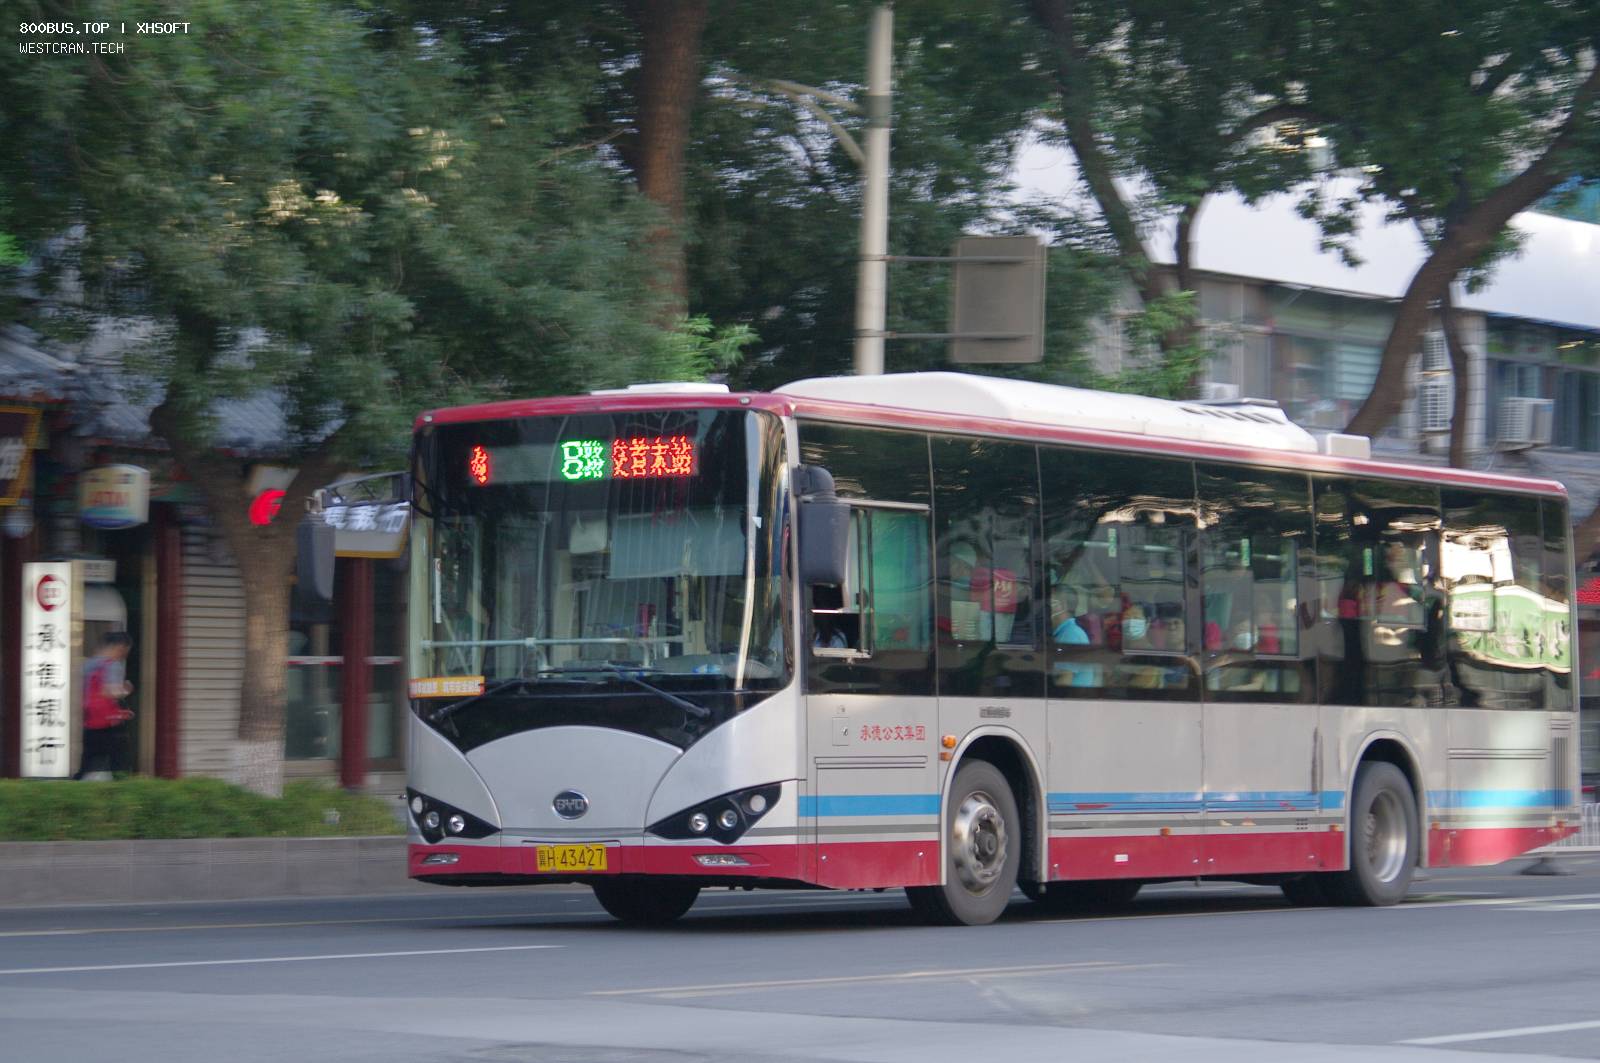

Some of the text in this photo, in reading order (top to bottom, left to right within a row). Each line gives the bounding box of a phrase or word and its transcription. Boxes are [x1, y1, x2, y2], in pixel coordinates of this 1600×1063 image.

[859, 724, 926, 741] 承德公交集团
[556, 799, 585, 812] BYD
